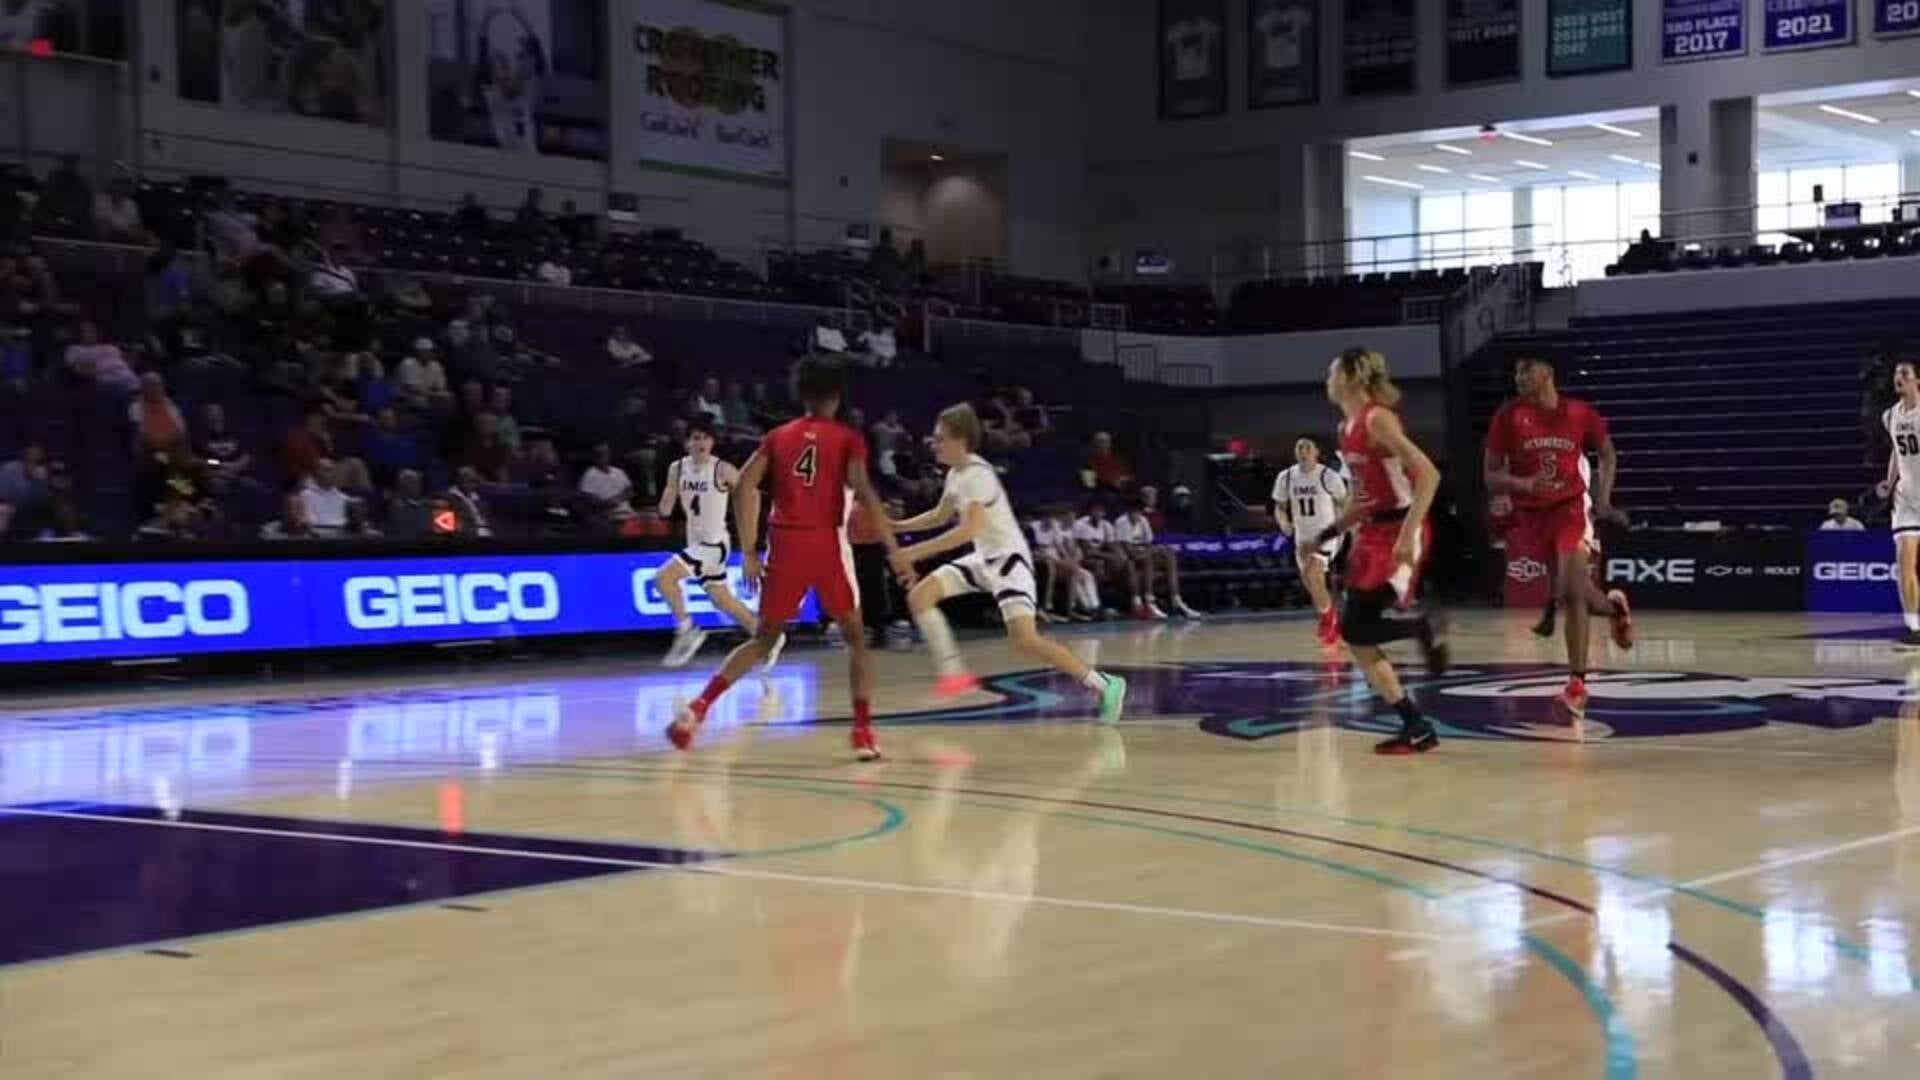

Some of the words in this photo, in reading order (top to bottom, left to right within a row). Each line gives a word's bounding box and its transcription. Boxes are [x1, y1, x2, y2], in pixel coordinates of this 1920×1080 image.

[1694, 15, 1739, 31] PLACE
[1776, 13, 1833, 38] 2021
[1674, 30, 1729, 55] 2017
[1896, 433, 1919, 456] 50
[793, 445, 817, 487] 4
[1540, 452, 1558, 481] 5
[682, 479, 708, 492] IMG
[690, 495, 701, 517] 4
[1299, 498, 1316, 517] 11
[1605, 558, 1695, 583] AXE
[1813, 561, 1899, 582] GEIC
[0, 579, 249, 645] GEICO
[344, 571, 559, 630] GEICO
